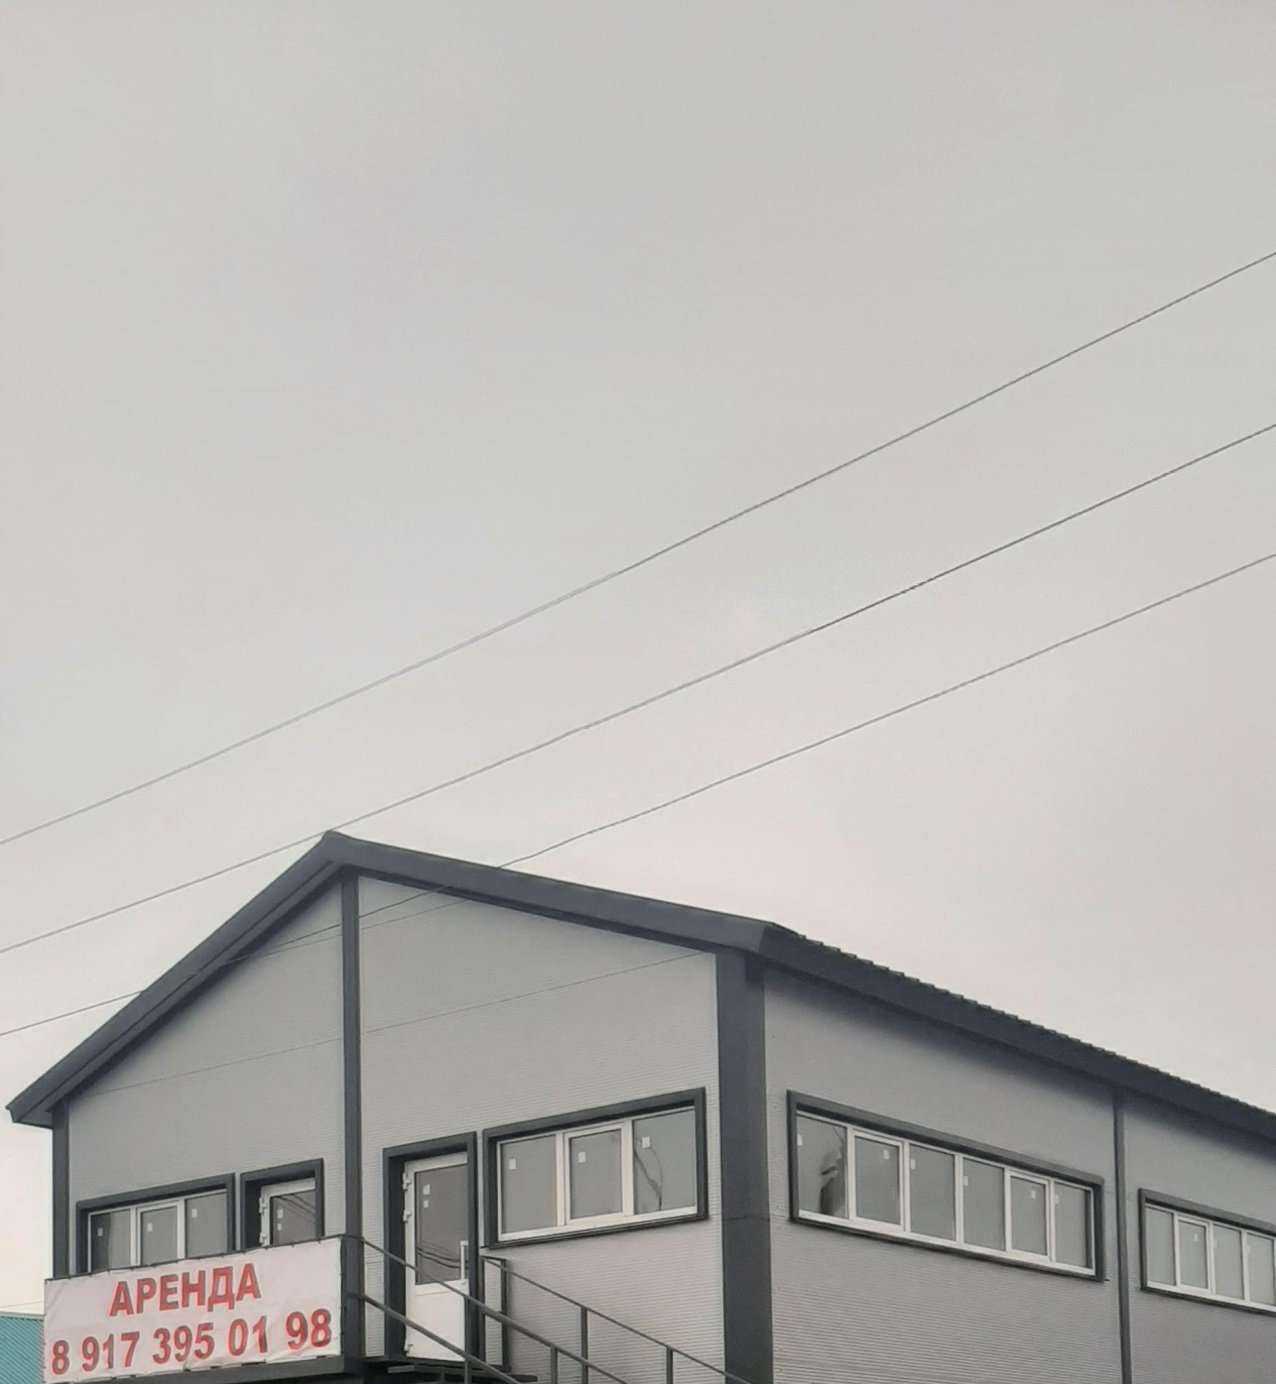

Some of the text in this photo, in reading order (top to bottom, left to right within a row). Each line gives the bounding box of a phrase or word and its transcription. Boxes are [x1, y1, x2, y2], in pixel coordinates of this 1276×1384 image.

[109, 1263, 262, 1317] АРЕНДА
[51, 1309, 332, 1375] 8 917 395 01 98
